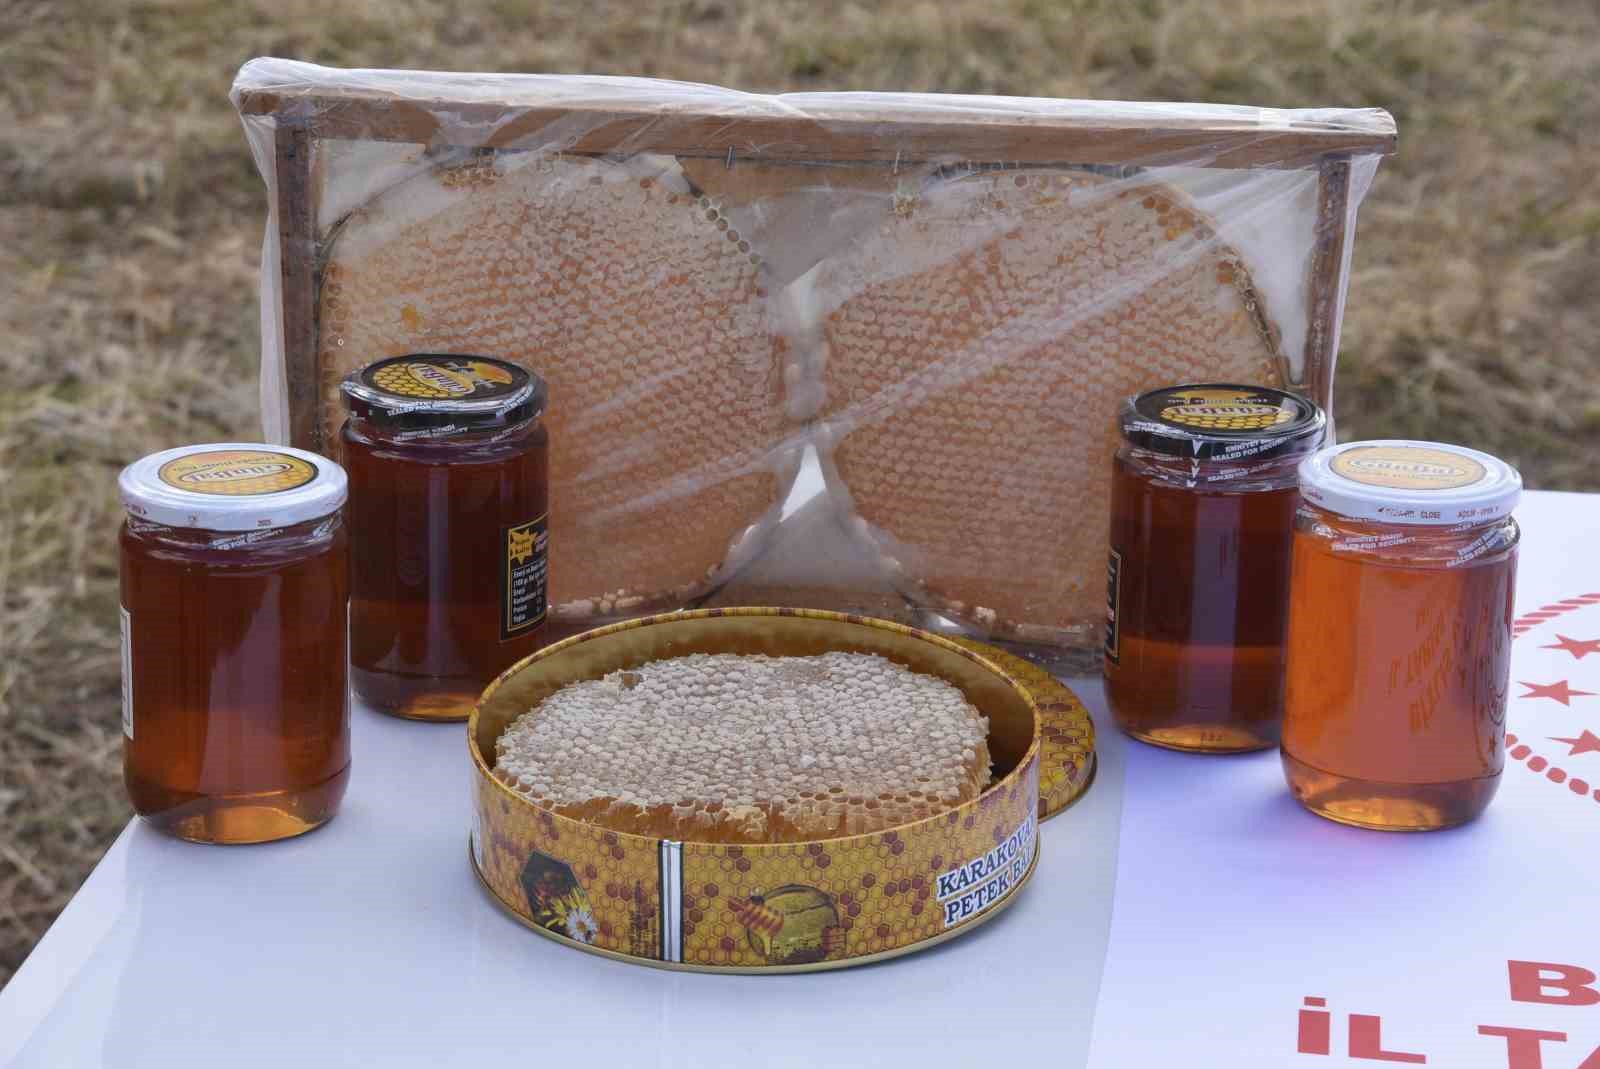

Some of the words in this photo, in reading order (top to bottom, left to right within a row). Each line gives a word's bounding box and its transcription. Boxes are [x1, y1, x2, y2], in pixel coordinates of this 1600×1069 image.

[938, 815, 1034, 898] KARAKOVA
[946, 869, 1010, 923] PETEK
[1297, 996, 1427, 1065] İL
[1477, 1024, 1600, 1069] T
